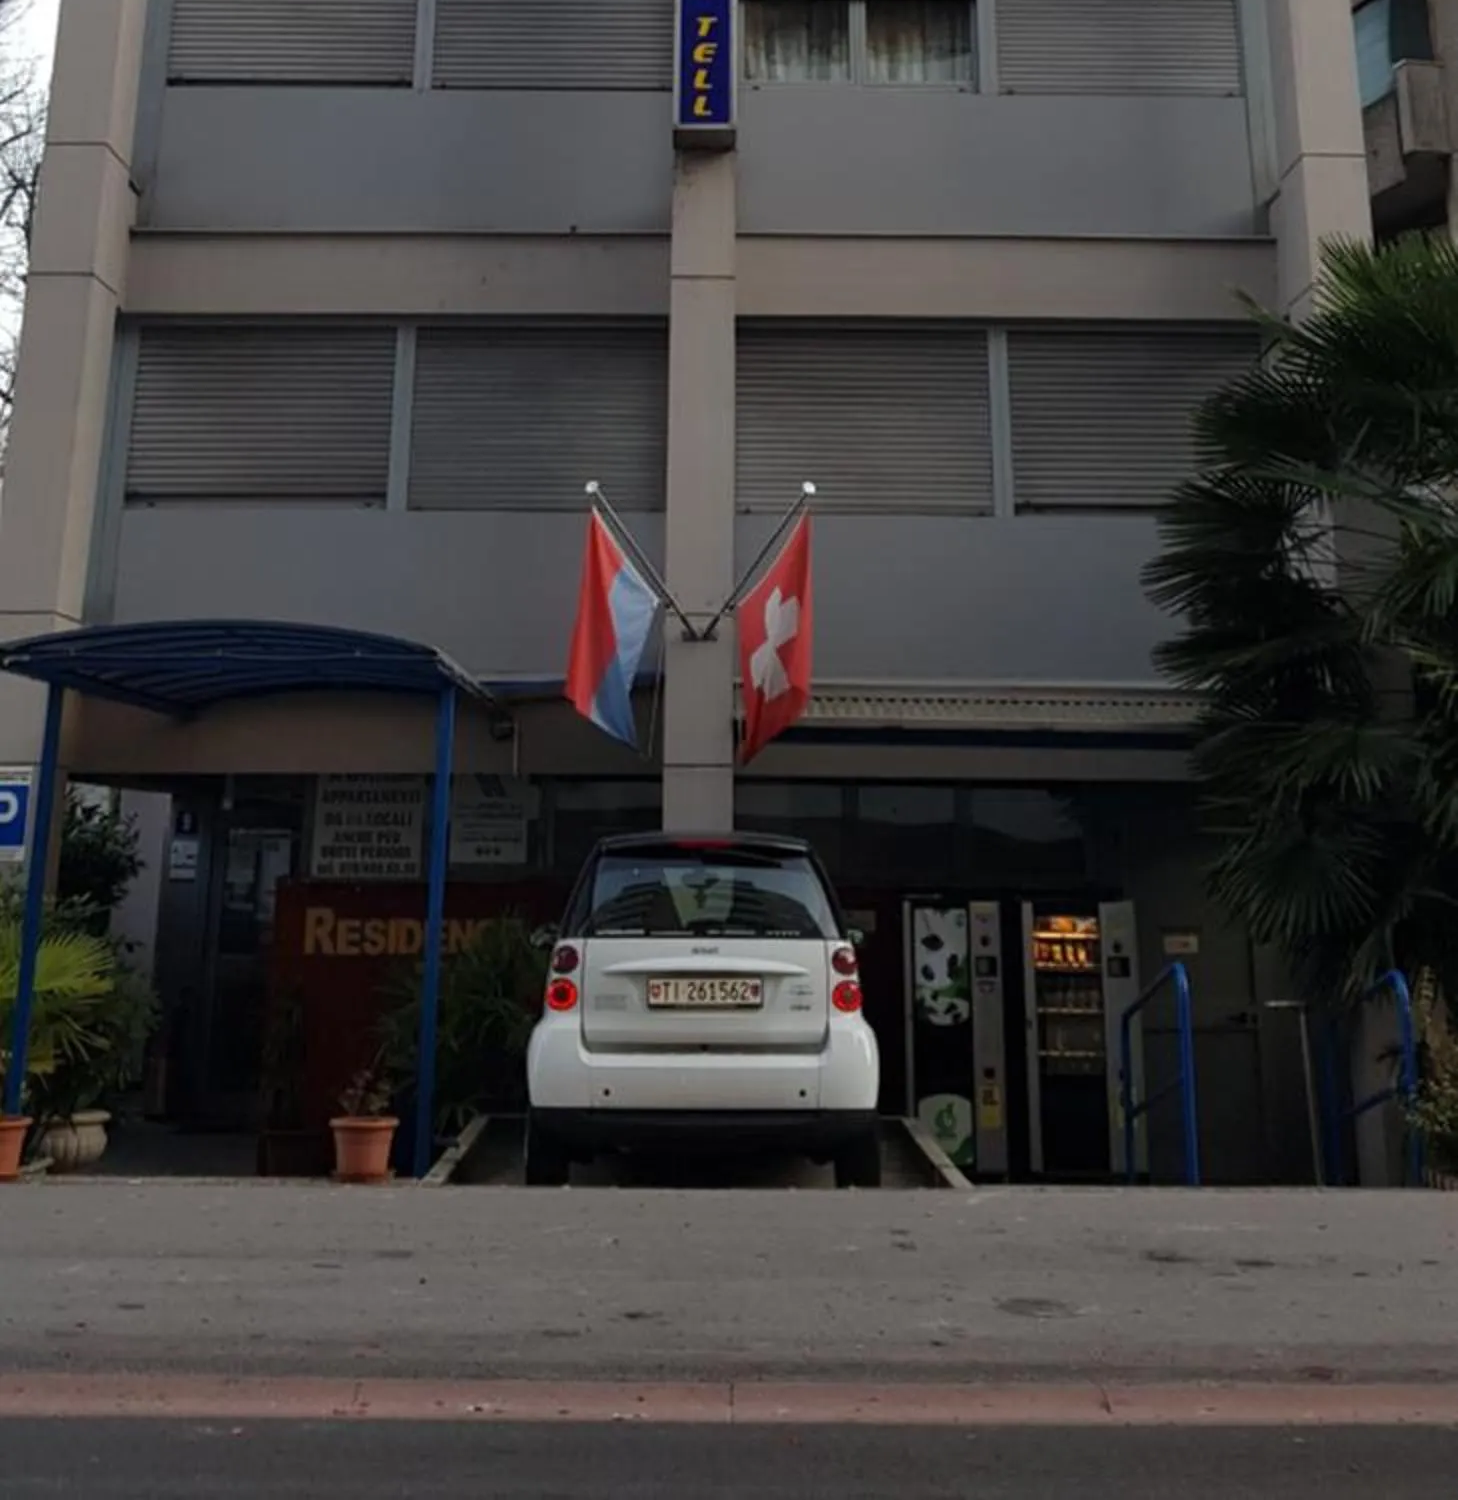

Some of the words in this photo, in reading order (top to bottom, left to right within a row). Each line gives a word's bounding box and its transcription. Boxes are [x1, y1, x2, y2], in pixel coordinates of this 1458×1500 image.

[692, 16, 719, 117] TELL
[303, 907, 522, 955] RESIDNC
[662, 981, 679, 1002] TI
[687, 981, 750, 1002] 261562
